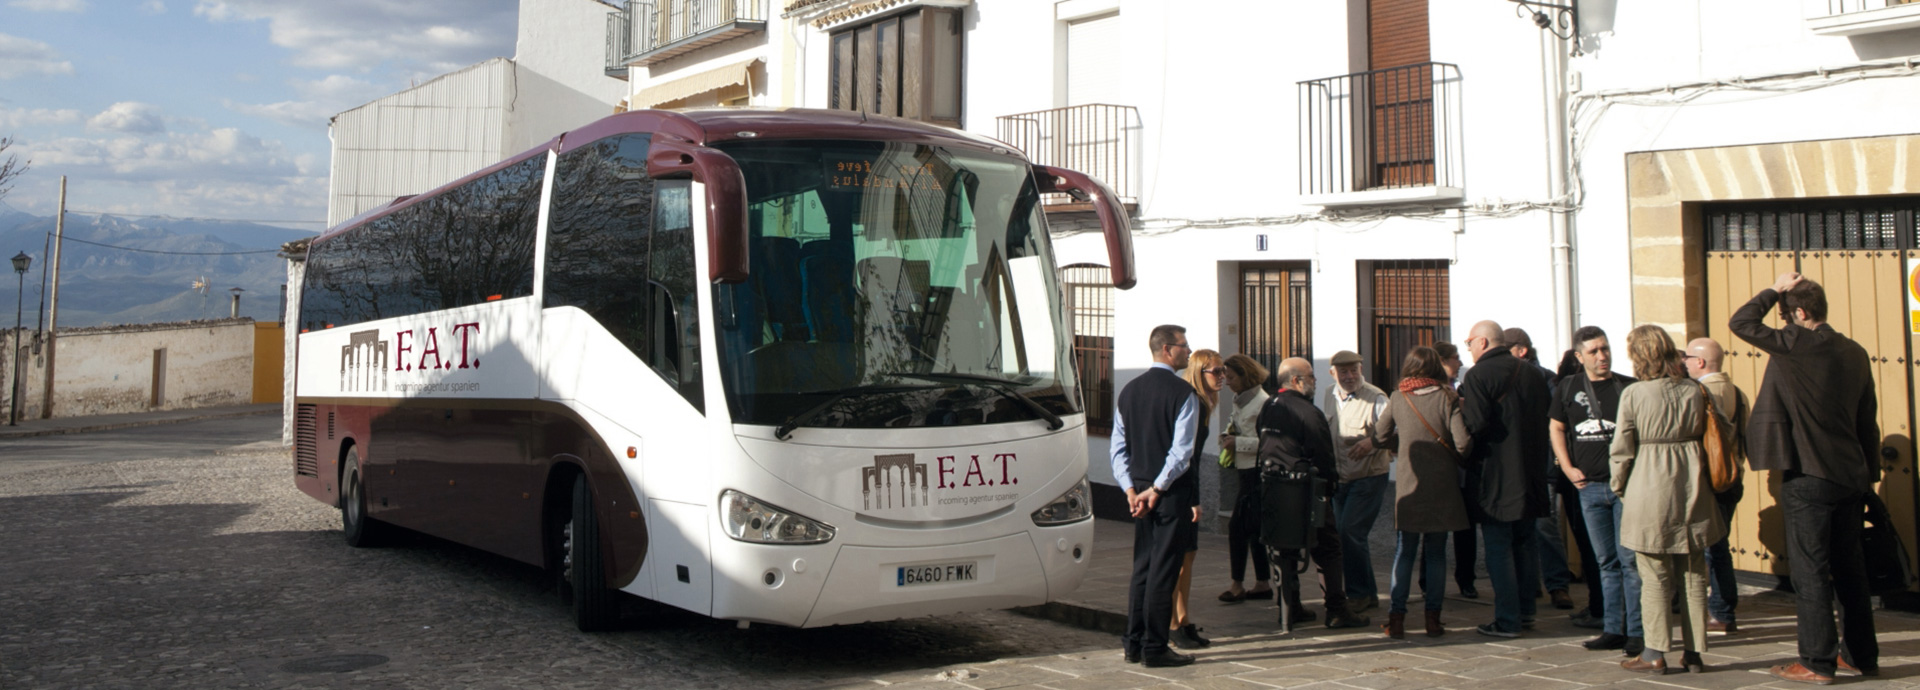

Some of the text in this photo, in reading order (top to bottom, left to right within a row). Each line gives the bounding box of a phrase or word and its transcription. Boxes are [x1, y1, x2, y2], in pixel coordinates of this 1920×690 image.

[395, 321, 480, 373] F.A.T.
[394, 380, 480, 394] incoming agentur spanien
[936, 453, 1018, 490] F.A.T.
[938, 492, 1019, 505] incoming agentur spanien
[906, 567, 942, 584] 6460
[946, 564, 973, 581] FWK
